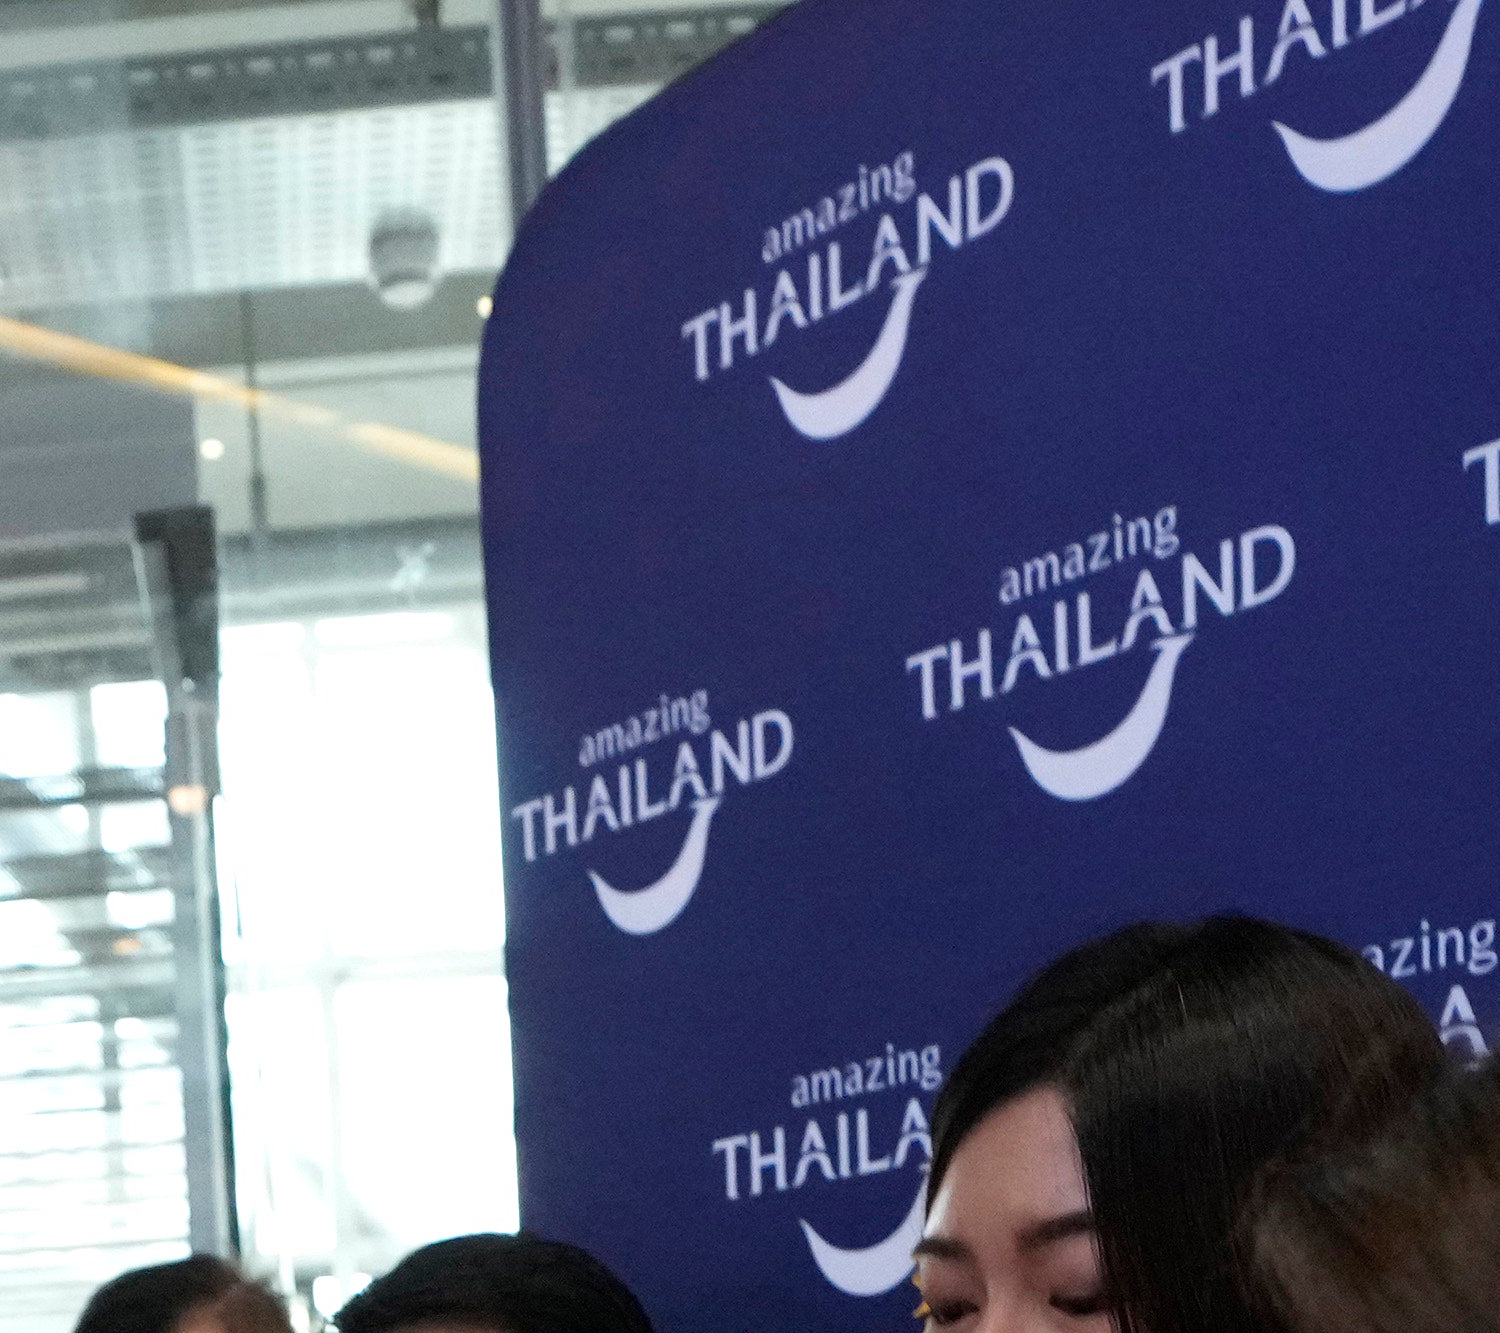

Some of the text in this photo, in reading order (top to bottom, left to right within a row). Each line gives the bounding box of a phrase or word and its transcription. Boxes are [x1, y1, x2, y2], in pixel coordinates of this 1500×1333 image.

[763, 152, 916, 263] amazing
[682, 157, 1013, 380] THAILAND
[1000, 506, 1180, 603] amazing
[907, 526, 1295, 718] THAILAND
[579, 690, 710, 767] amazing
[512, 709, 795, 862] THAILAND
[791, 1042, 943, 1109] amazing
[712, 1097, 934, 1201] THAILA
